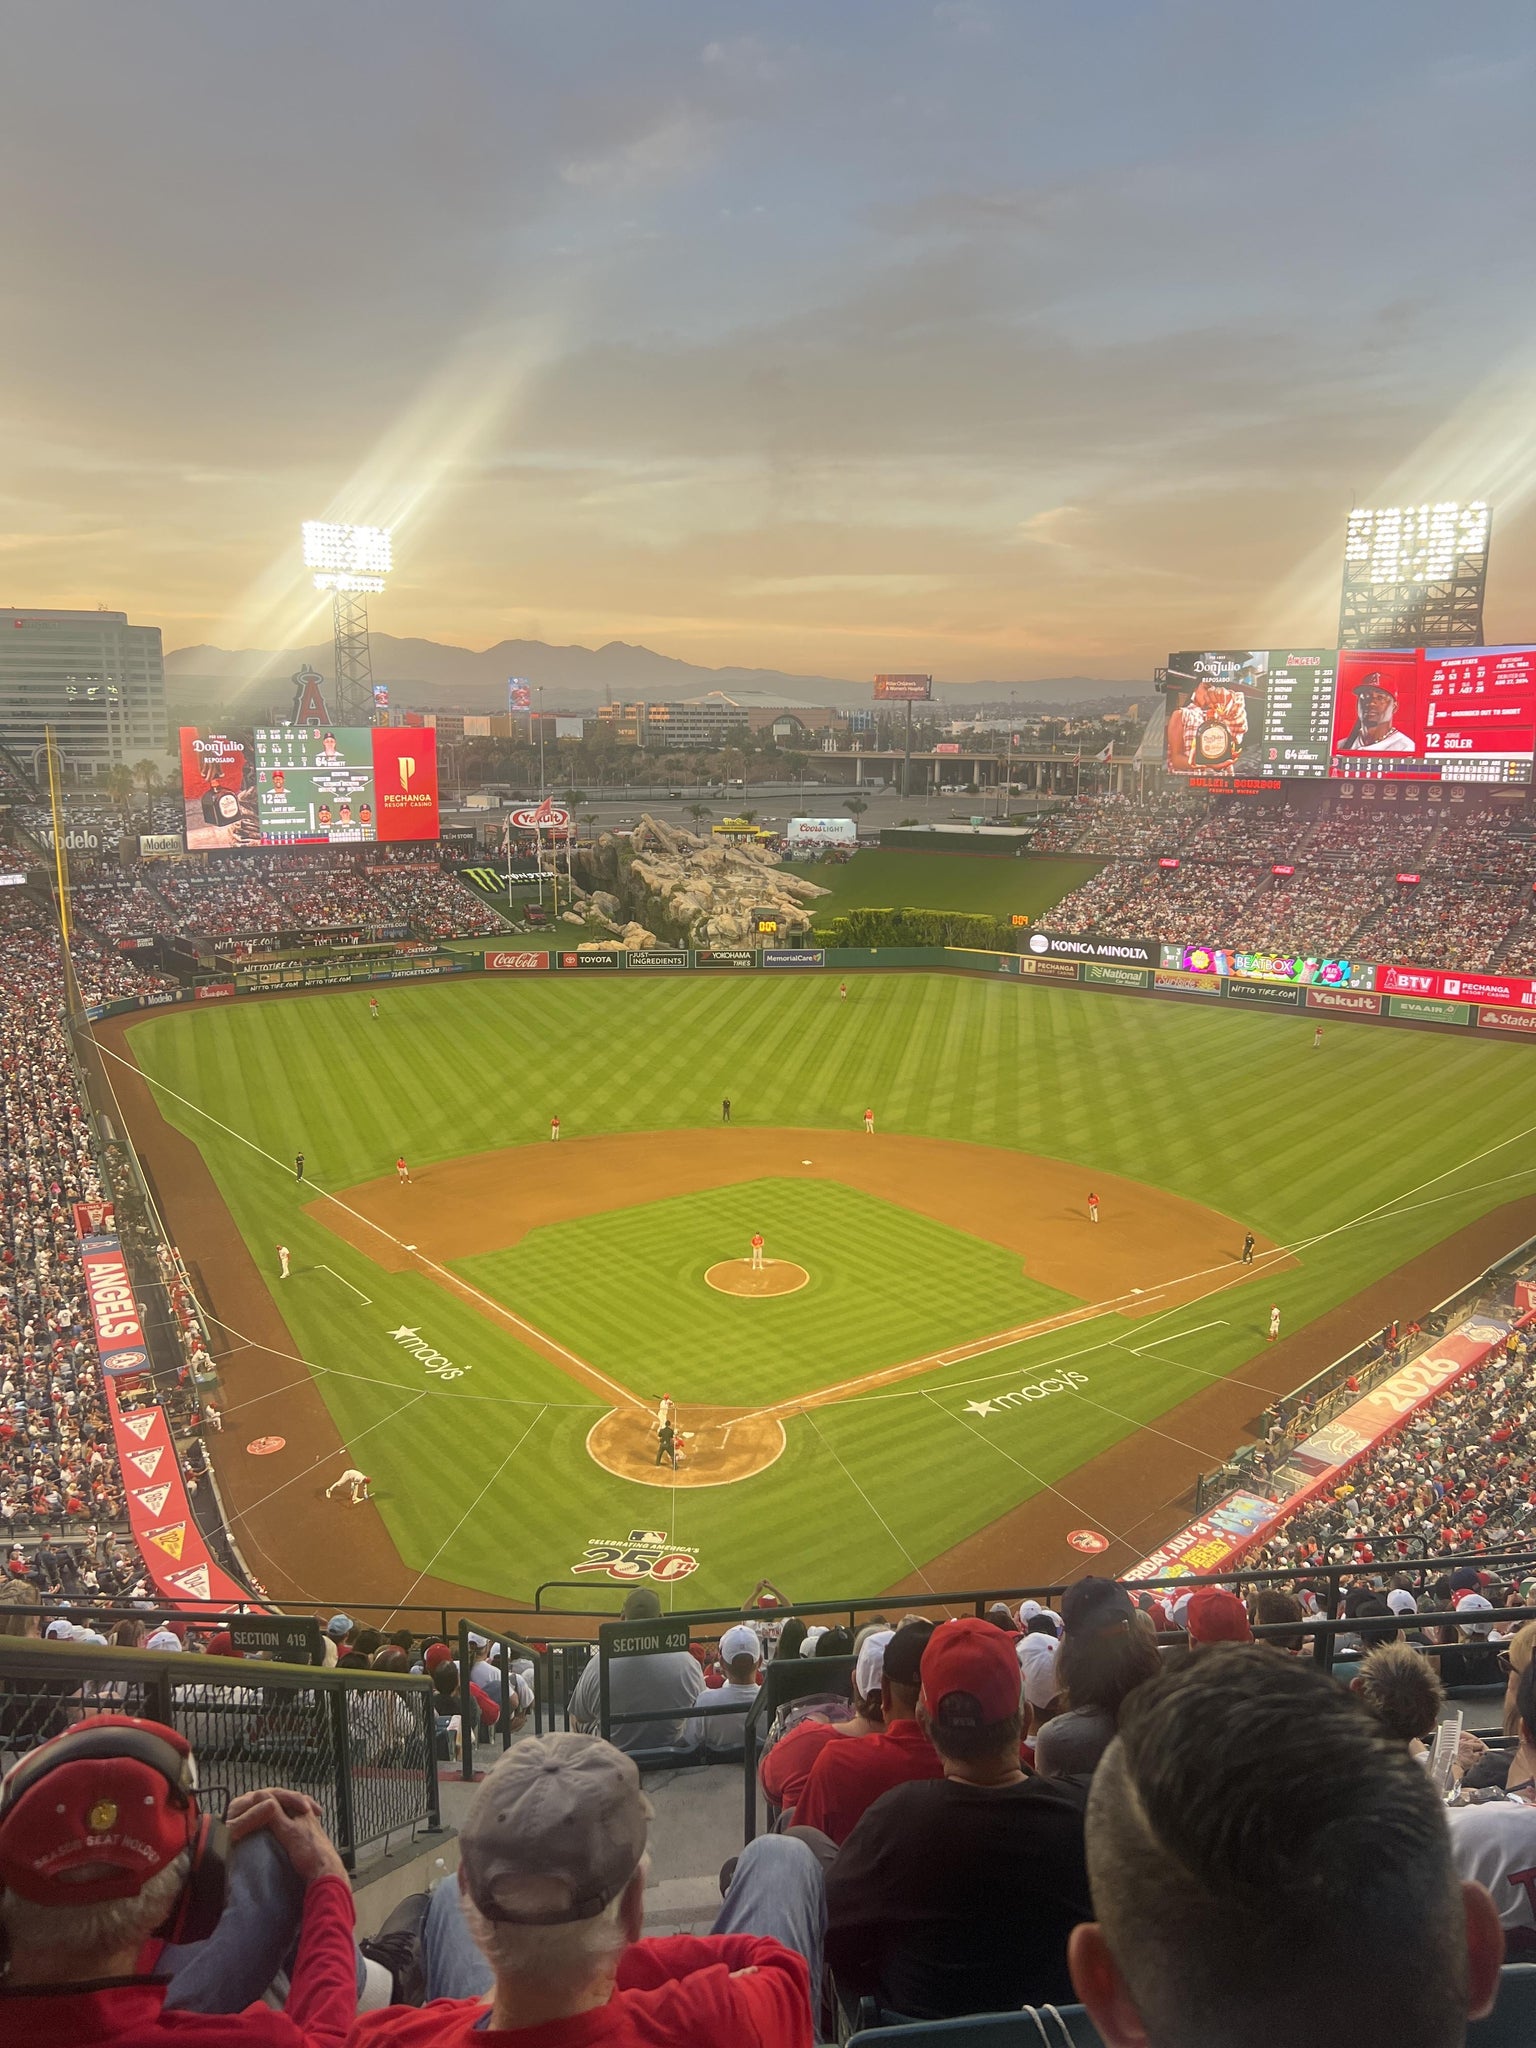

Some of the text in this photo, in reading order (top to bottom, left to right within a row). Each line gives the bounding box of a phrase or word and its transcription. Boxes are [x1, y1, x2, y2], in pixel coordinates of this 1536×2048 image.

[1286, 653, 1320, 666] ANGELS
[1426, 733, 1440, 747] 12
[1444, 739, 1473, 748] SOLER
[1285, 749, 1297, 759] 64
[315, 757, 327, 766] 64
[1233, 779, 1281, 789] BOURBON
[261, 794, 273, 804] 12
[384, 794, 431, 803] PECHANGA
[800, 823, 822, 832] Coors
[147, 838, 178, 850] Modelo
[1012, 915, 1028, 925] 0:09
[759, 921, 776, 931] 0:09
[1051, 940, 1148, 960] KONICA MINOLTA
[767, 954, 812, 962] MemorialCare
[1038, 962, 1074, 972] PECHANGA
[1236, 957, 1292, 973] BEATBOX
[325, 976, 351, 984] TIRE.COM
[1102, 968, 1142, 981] National
[271, 982, 298, 990] TIRE.COM
[1158, 976, 1196, 987] Surfside
[1366, 981, 1371, 989] 9
[1231, 984, 1296, 999] NITTO TIRE.COM
[1462, 983, 1510, 994] PECHANGA
[148, 994, 172, 1005] Modelo
[1312, 992, 1376, 1009] Yakult
[1424, 1005, 1443, 1013] AIR
[88, 1263, 139, 1338] ANGELS
[1368, 1356, 1460, 1413] 2026
[1166, 1531, 1198, 1556] JULY
[1192, 1521, 1212, 1535] 31
[588, 1538, 700, 1553] CELEBRATING AMERICA'S
[1187, 1537, 1232, 1569] JERSEY
[233, 1632, 306, 1647] SECTION 419
[613, 1633, 686, 1652] SECTION 420
[86, 1834, 121, 1847] SEAT
